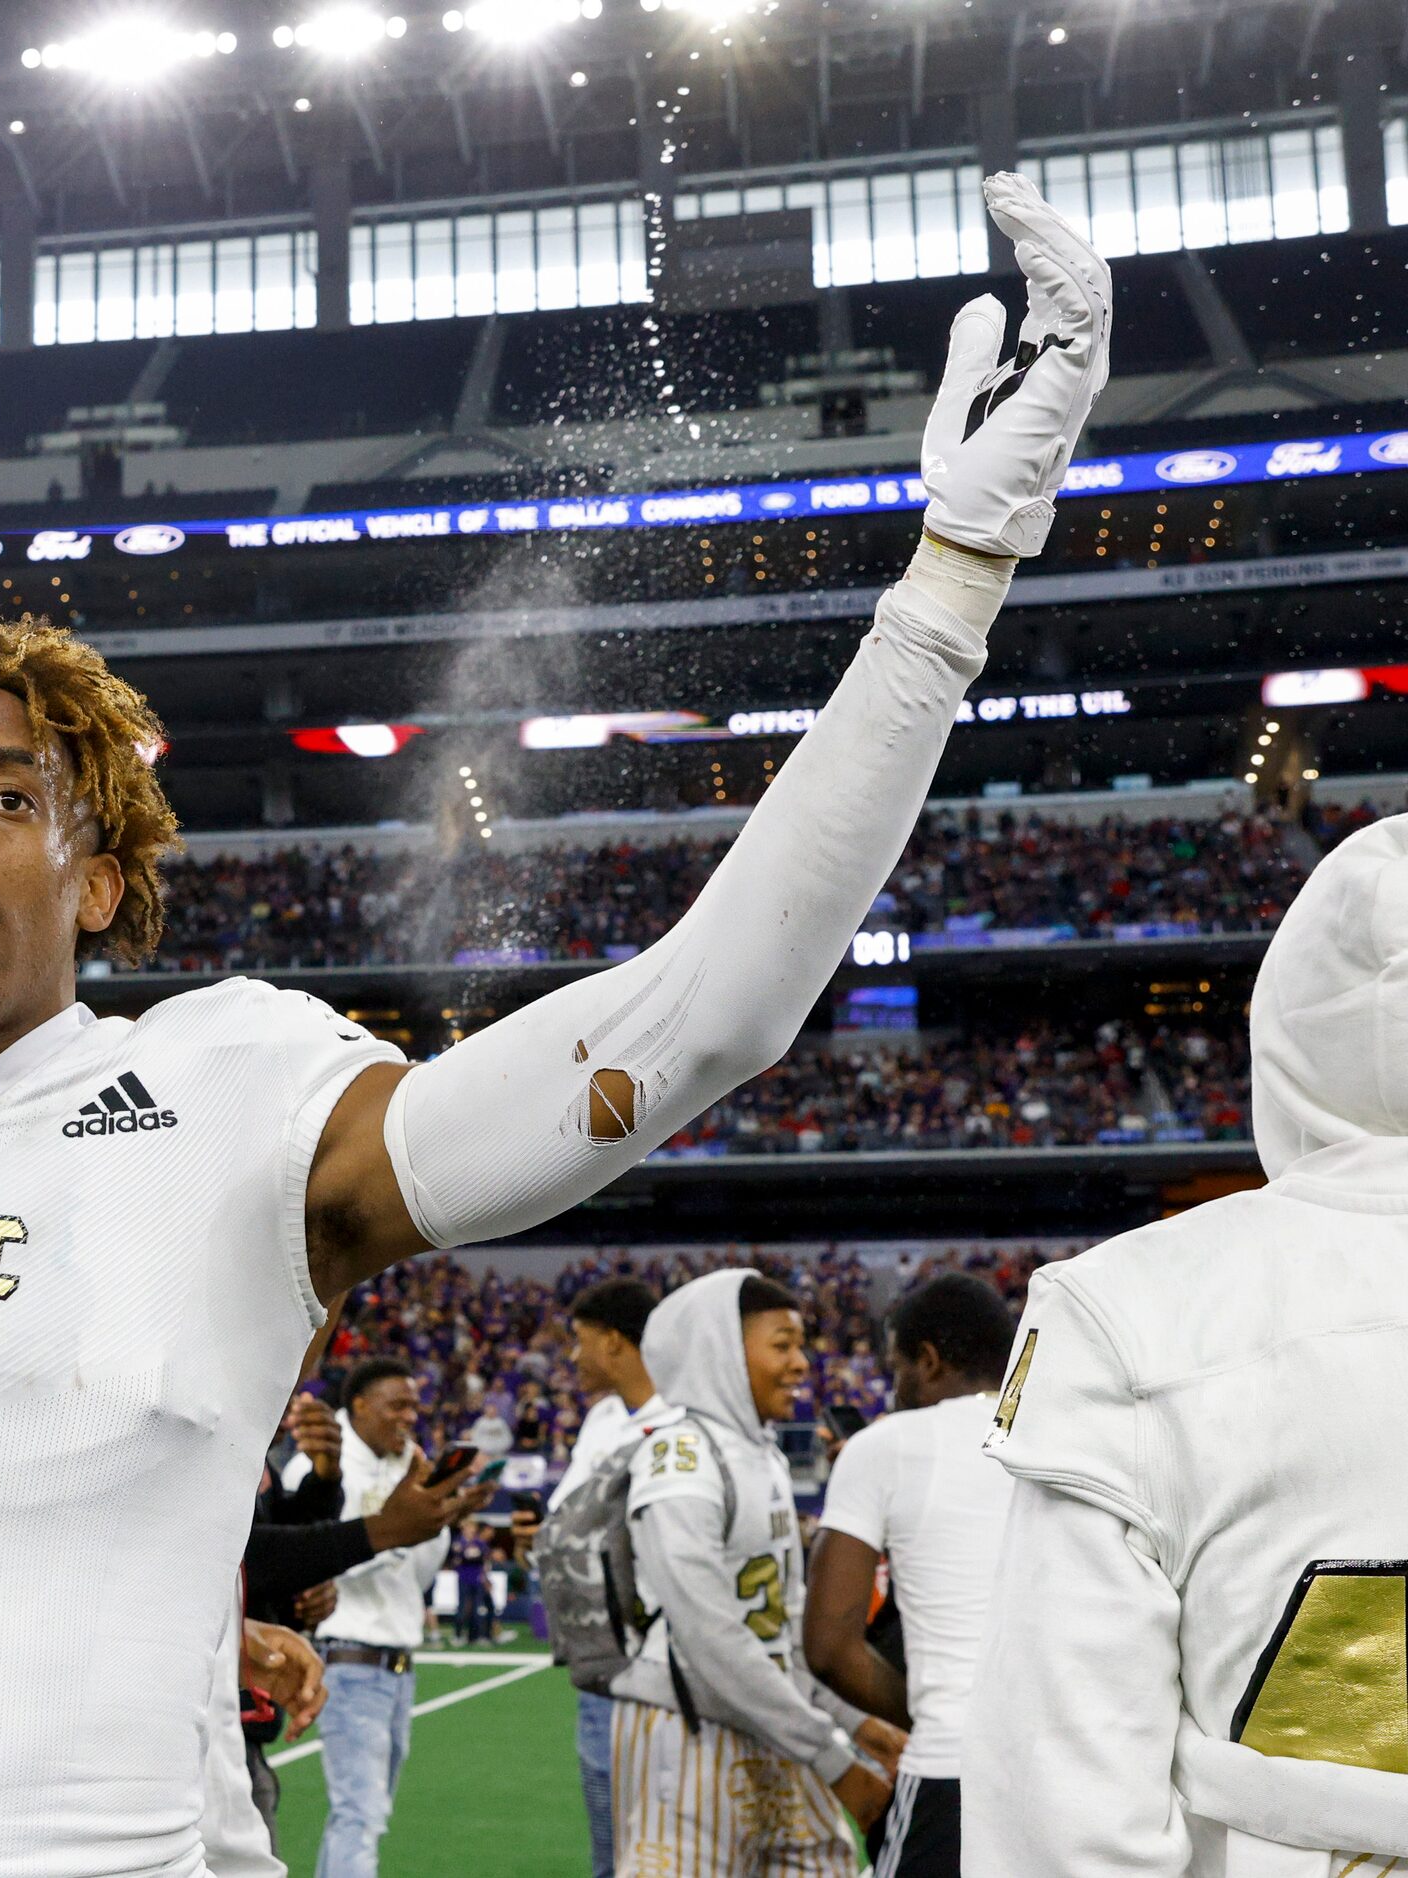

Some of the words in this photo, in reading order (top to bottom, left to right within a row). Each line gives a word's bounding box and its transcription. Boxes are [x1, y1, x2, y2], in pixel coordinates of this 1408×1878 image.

[1266, 441, 1342, 476] Ford
[810, 483, 870, 509] FORD
[875, 480, 901, 505] IS
[225, 523, 268, 547] THE
[272, 519, 361, 545] OFFICIAL
[365, 512, 451, 539] VEHICLE
[457, 509, 489, 533] OF
[494, 506, 539, 531] THE
[548, 502, 629, 527] DALLAS
[641, 492, 742, 522] COWBOYS
[27, 531, 92, 561] Ford
[978, 698, 1017, 721] OF
[1020, 694, 1077, 718] THE
[1080, 690, 1132, 714] UIL
[728, 709, 824, 736] OFFICI
[62, 1109, 178, 1138] adidas
[650, 1435, 701, 1478] 25
